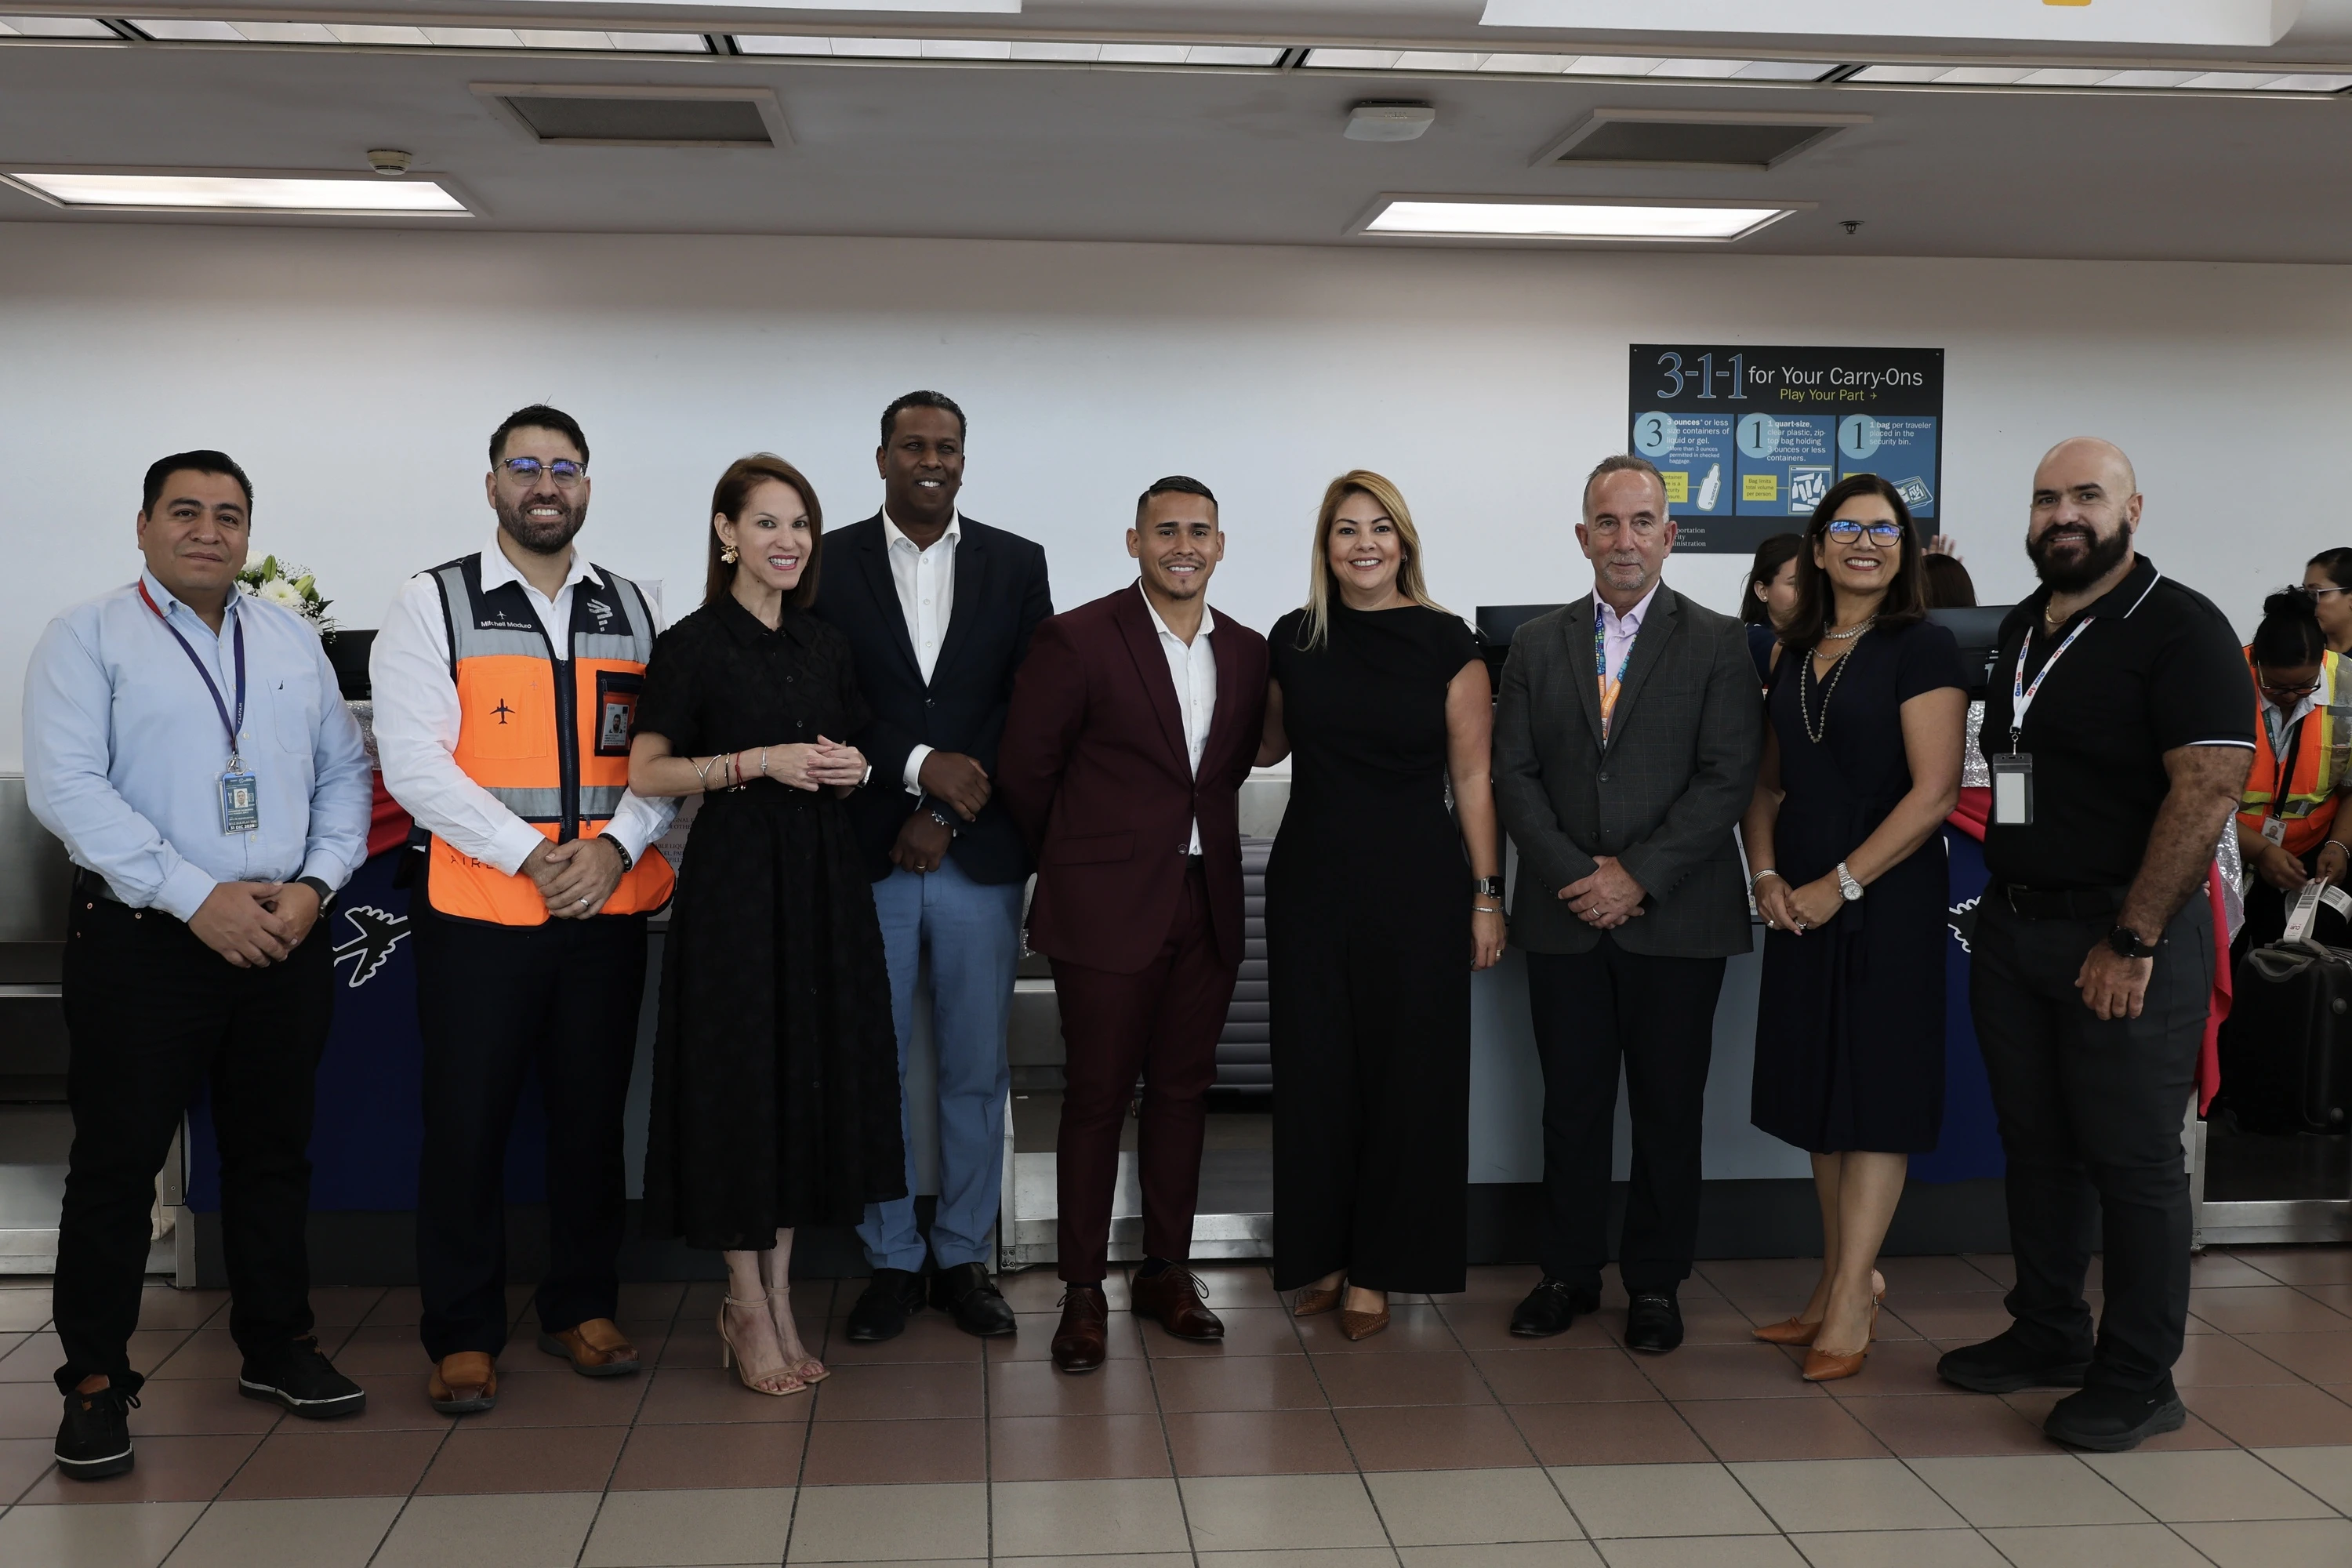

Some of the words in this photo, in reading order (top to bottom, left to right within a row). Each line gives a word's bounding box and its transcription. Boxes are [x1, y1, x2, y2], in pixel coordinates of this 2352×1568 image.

[1657, 352, 1748, 399] 3-1-1
[1748, 366, 1775, 383] for
[1782, 367, 1824, 385] Your
[1830, 367, 1923, 389] Carry-Ons
[1780, 388, 1805, 402] Play
[1809, 389, 1836, 401] Your
[1840, 389, 1864, 401] Part
[1647, 419, 1662, 447] 3
[1752, 421, 1763, 448] 1
[1775, 420, 1812, 429] quart-size,
[1854, 421, 1865, 450] 1
